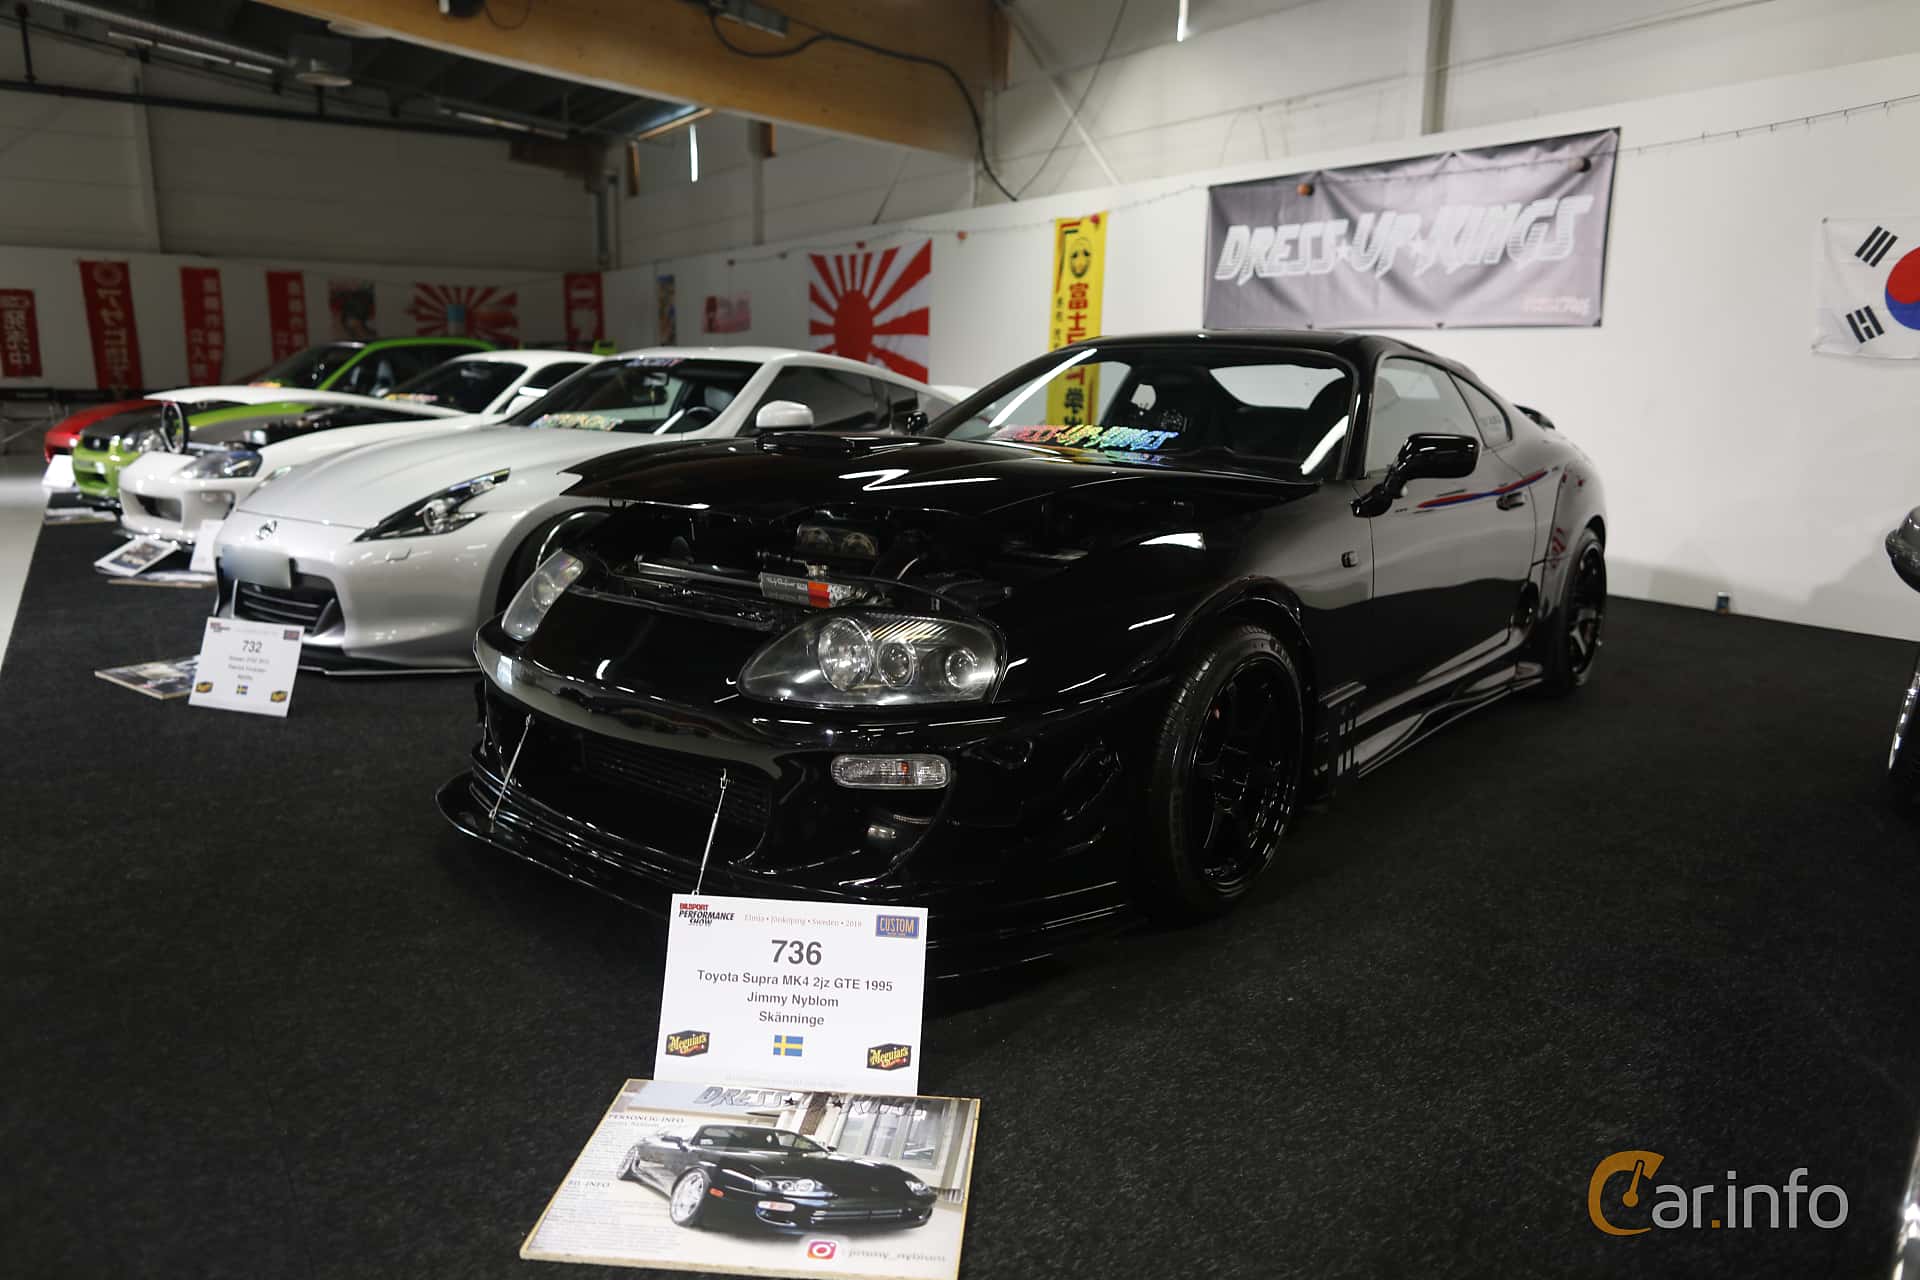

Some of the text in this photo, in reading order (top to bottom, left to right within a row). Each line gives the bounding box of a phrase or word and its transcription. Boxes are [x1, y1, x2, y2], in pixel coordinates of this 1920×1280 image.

[1215, 195, 1594, 285] DRESS UP KINGS
[242, 639, 263, 654] 732
[678, 910, 736, 921] PERFORMANCE
[688, 919, 713, 927] SHOW
[879, 916, 915, 934] CUSTOM
[771, 939, 822, 966] 736
[697, 969, 893, 992] Toyota Supra MK4 2jz GTE 1995
[746, 991, 839, 1008] Jimmy Nyblom
[759, 1010, 825, 1028] Skänninge
